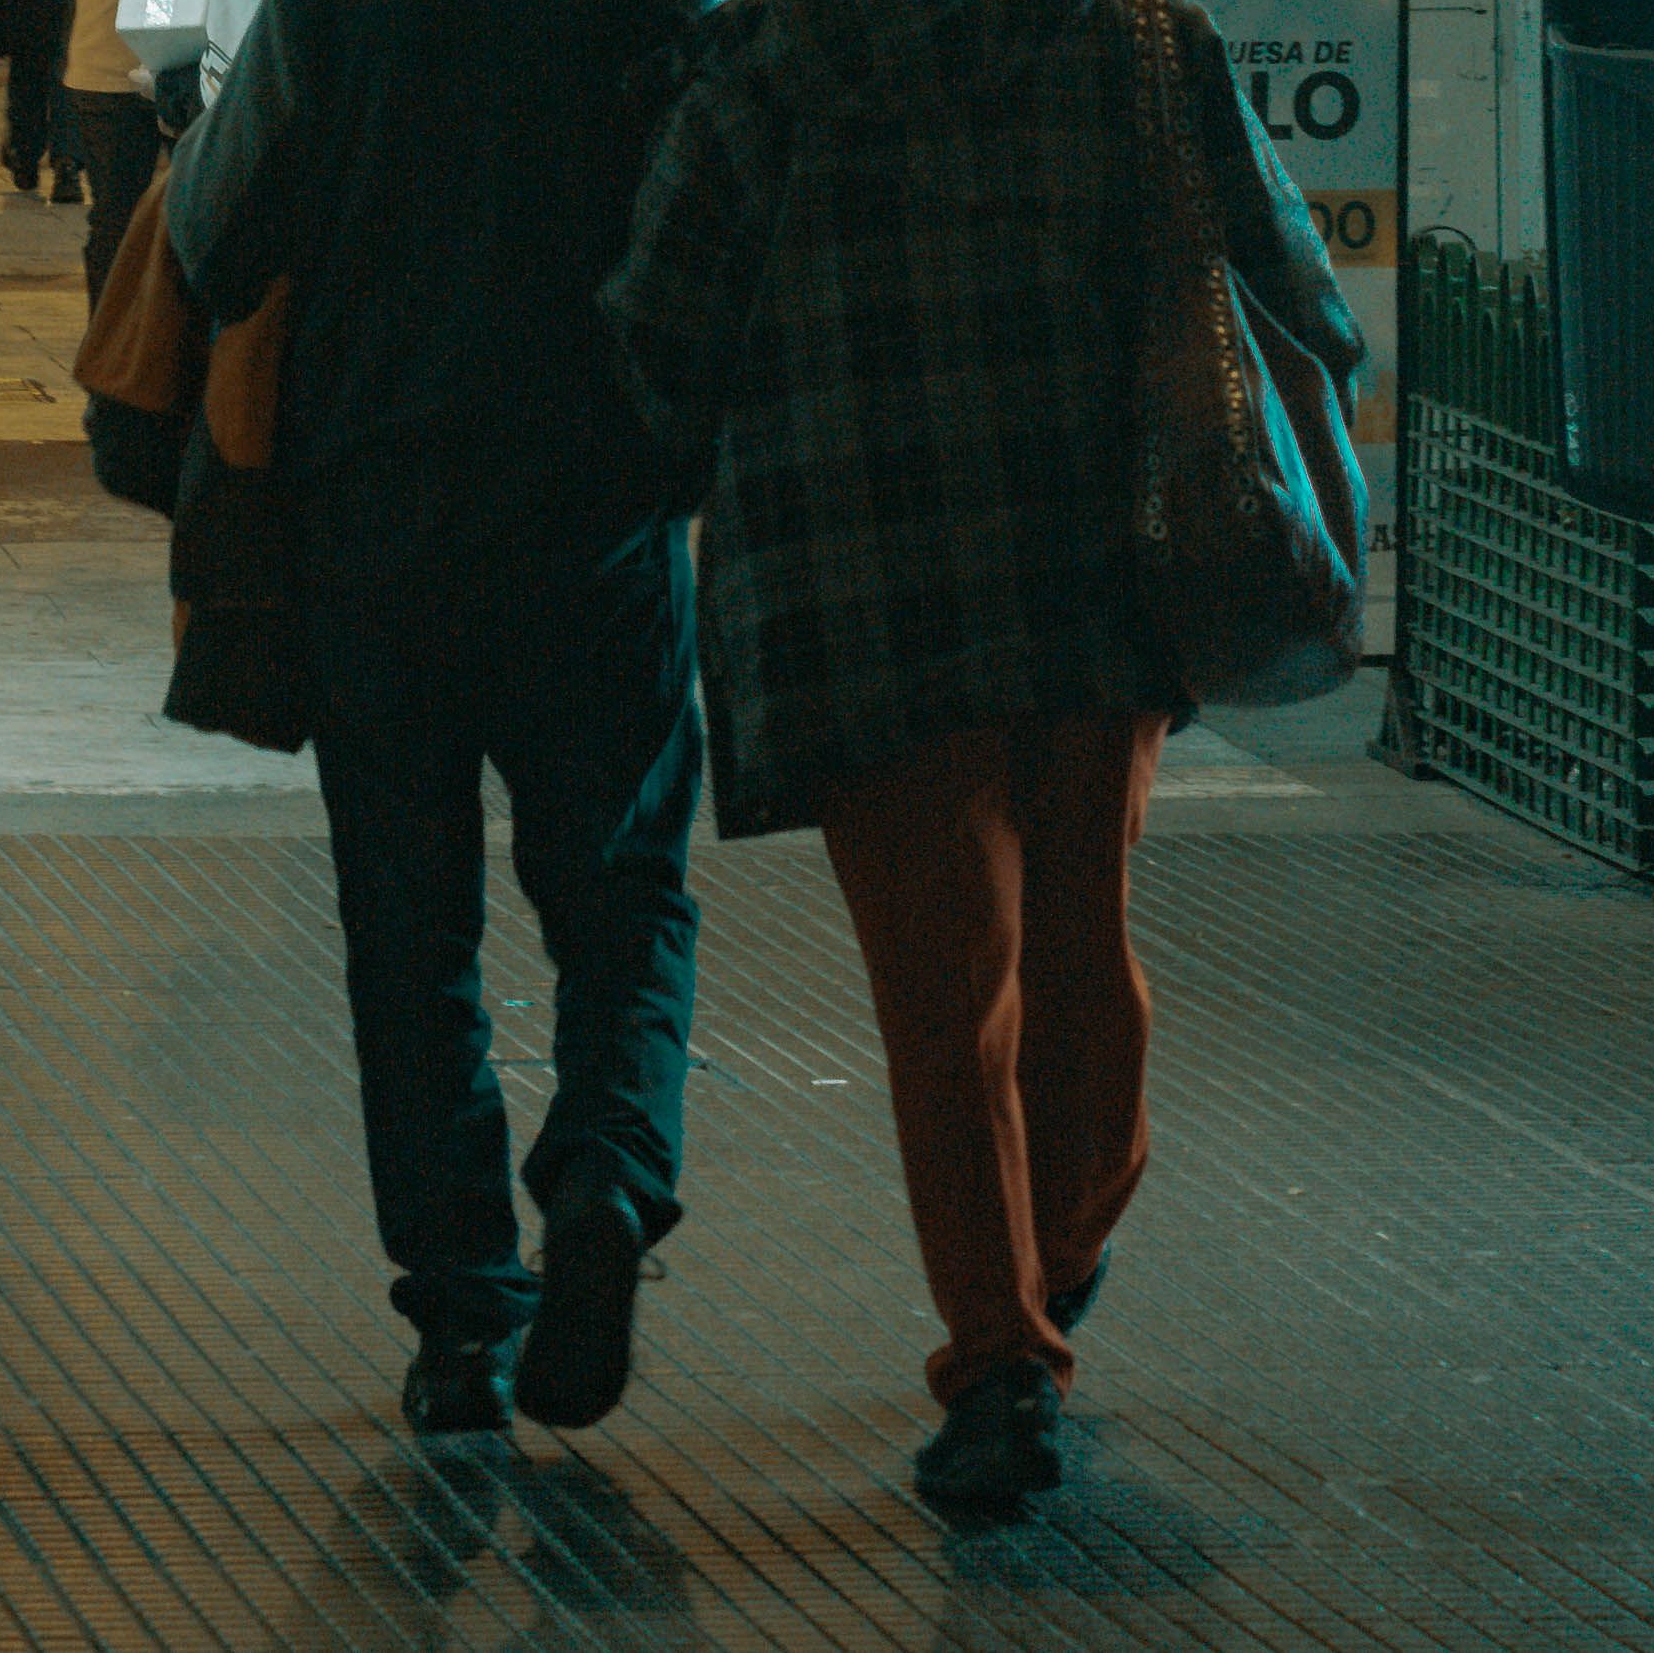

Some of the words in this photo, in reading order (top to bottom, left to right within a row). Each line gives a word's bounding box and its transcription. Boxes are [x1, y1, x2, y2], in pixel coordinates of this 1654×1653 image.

[1227, 40, 1304, 64] UESA
[1313, 40, 1353, 64] DE
[1249, 70, 1361, 141] LO
